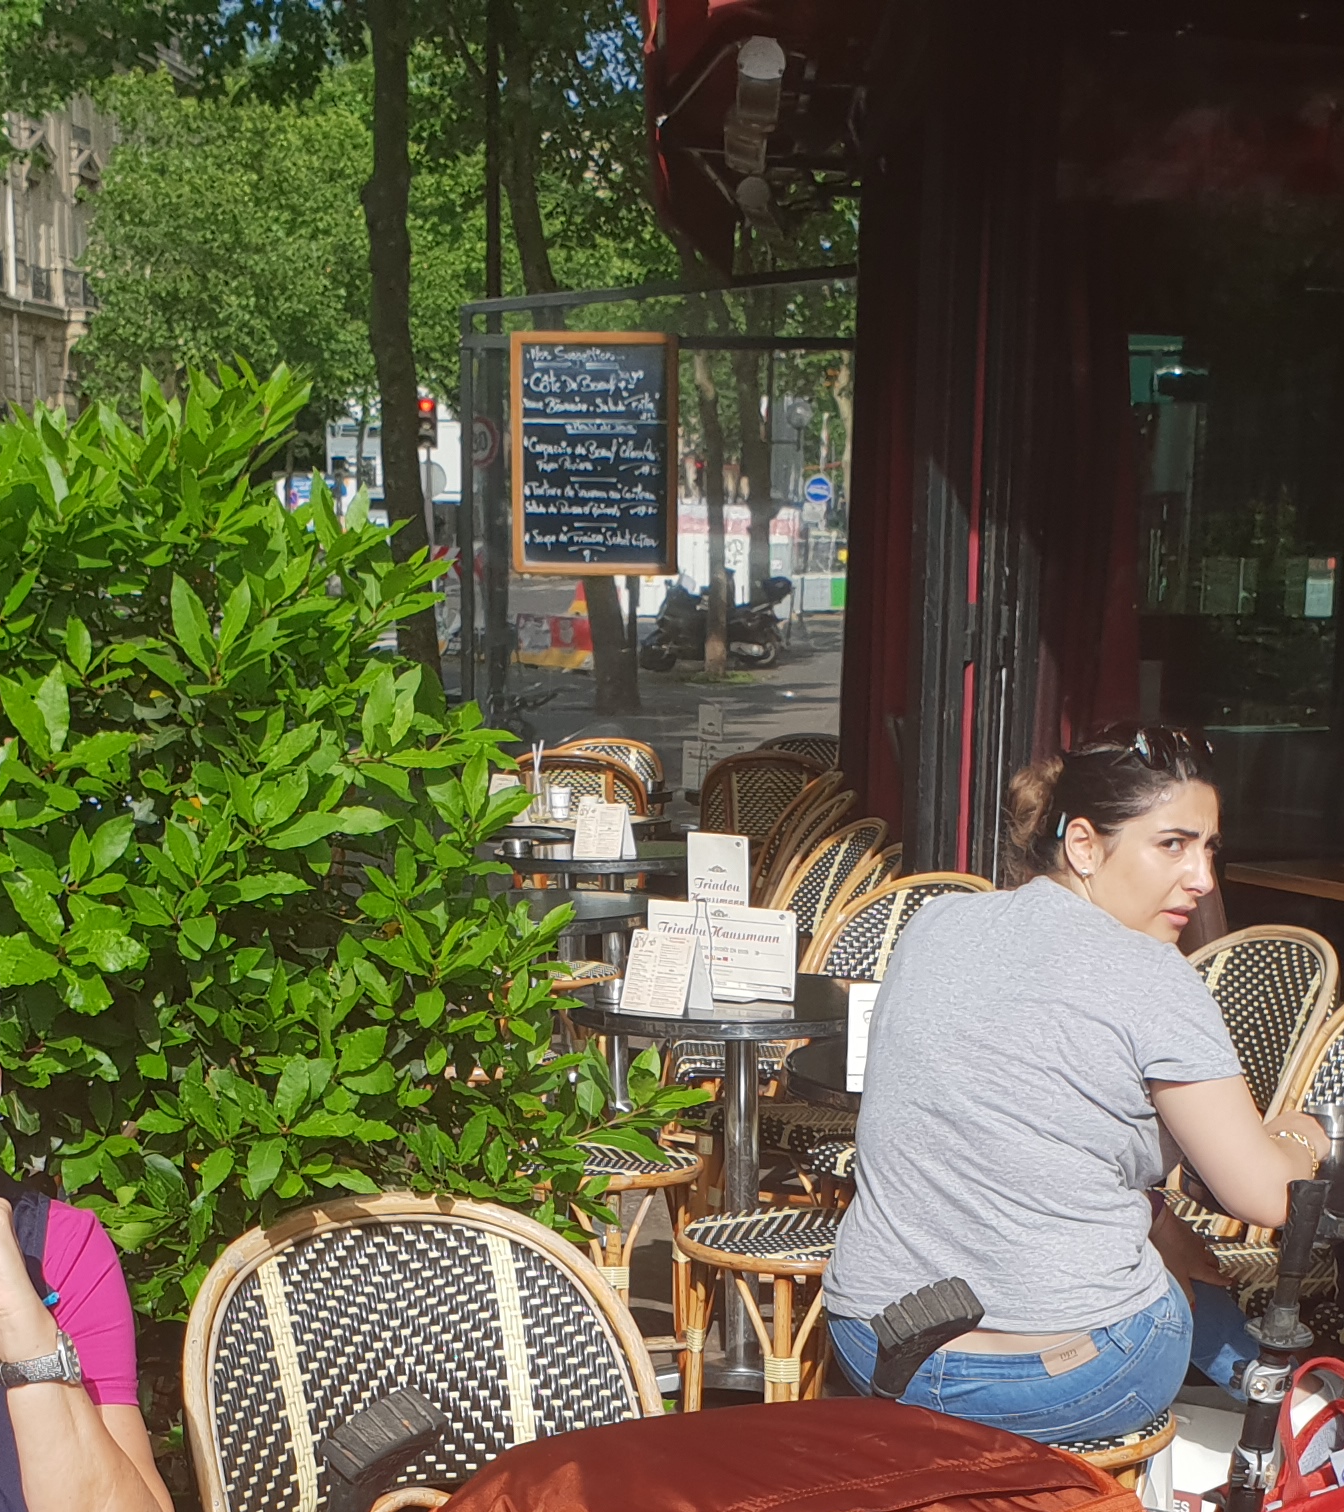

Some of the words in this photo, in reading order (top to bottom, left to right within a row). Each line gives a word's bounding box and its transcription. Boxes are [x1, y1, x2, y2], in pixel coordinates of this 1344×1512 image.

[693, 877, 741, 893] Triadou
[690, 891, 745, 906] Hussmann
[657, 921, 707, 937] Triadou
[710, 925, 781, 943] Haussmann
